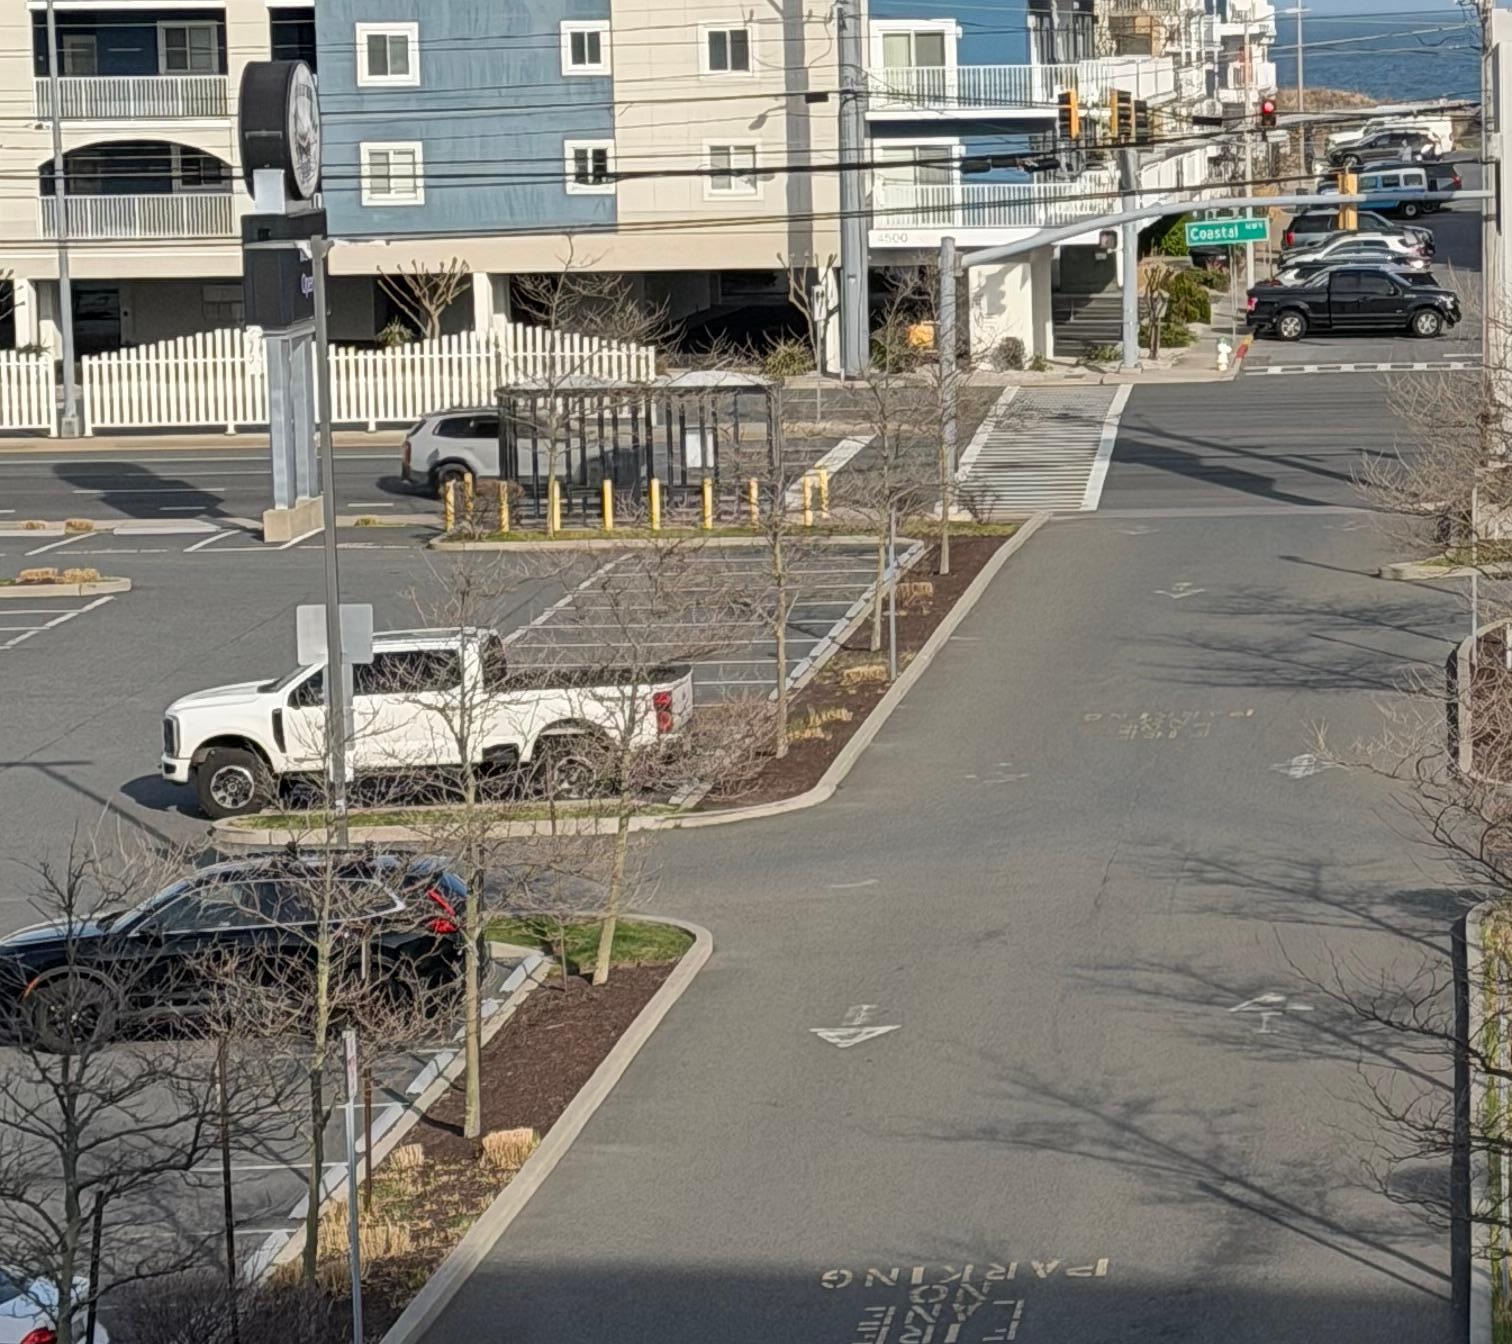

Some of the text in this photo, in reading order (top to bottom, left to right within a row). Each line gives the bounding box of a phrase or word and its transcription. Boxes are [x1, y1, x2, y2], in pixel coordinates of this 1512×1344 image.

[1190, 224, 1238, 241] Coastal
[819, 1257, 1110, 1290] PARKING
[908, 1281, 990, 1304] NO
